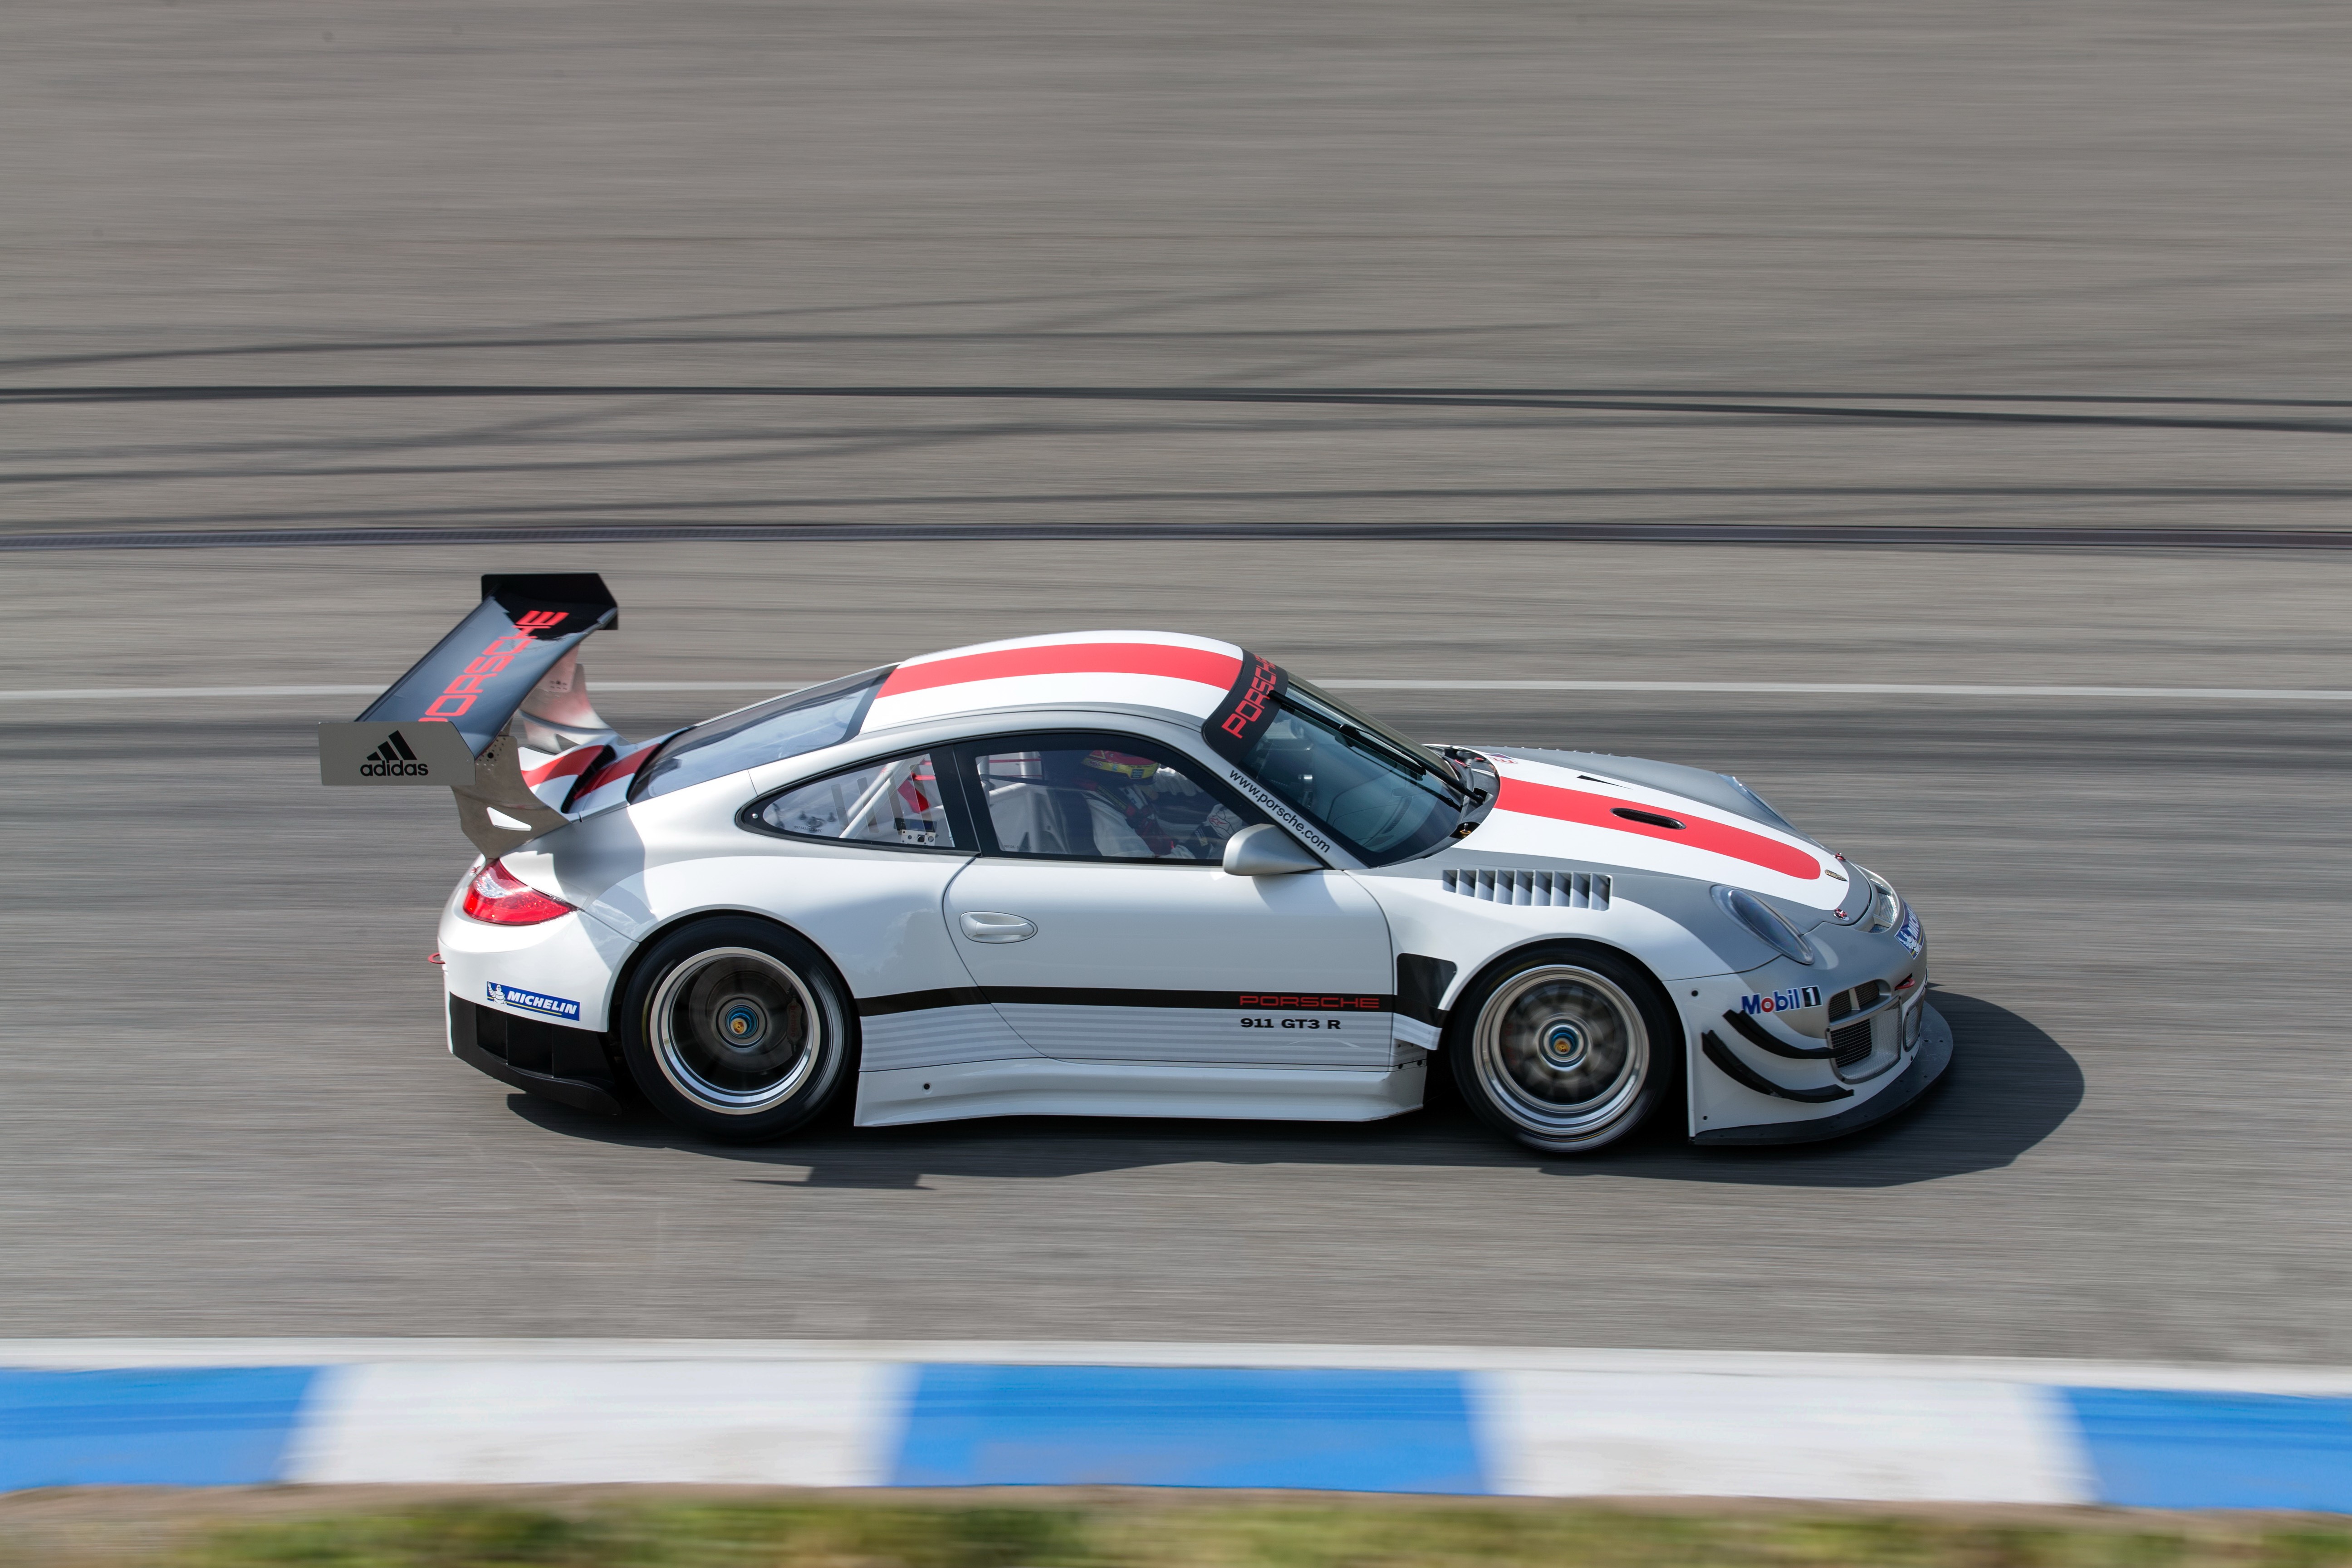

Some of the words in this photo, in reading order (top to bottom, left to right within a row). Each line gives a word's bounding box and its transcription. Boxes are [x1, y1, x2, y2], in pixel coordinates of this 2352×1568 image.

[418, 610, 569, 722] ORSCHE
[360, 760, 429, 777] adidas
[1229, 769, 1331, 853] www.porsche.com
[507, 990, 577, 1014] MICHELIN
[1240, 995, 1380, 1009] PORSCHE
[1741, 988, 1801, 1015] Mobil
[1240, 1018, 1274, 1028] 911
[1281, 1019, 1320, 1029] GT3
[1327, 1019, 1341, 1029] R
